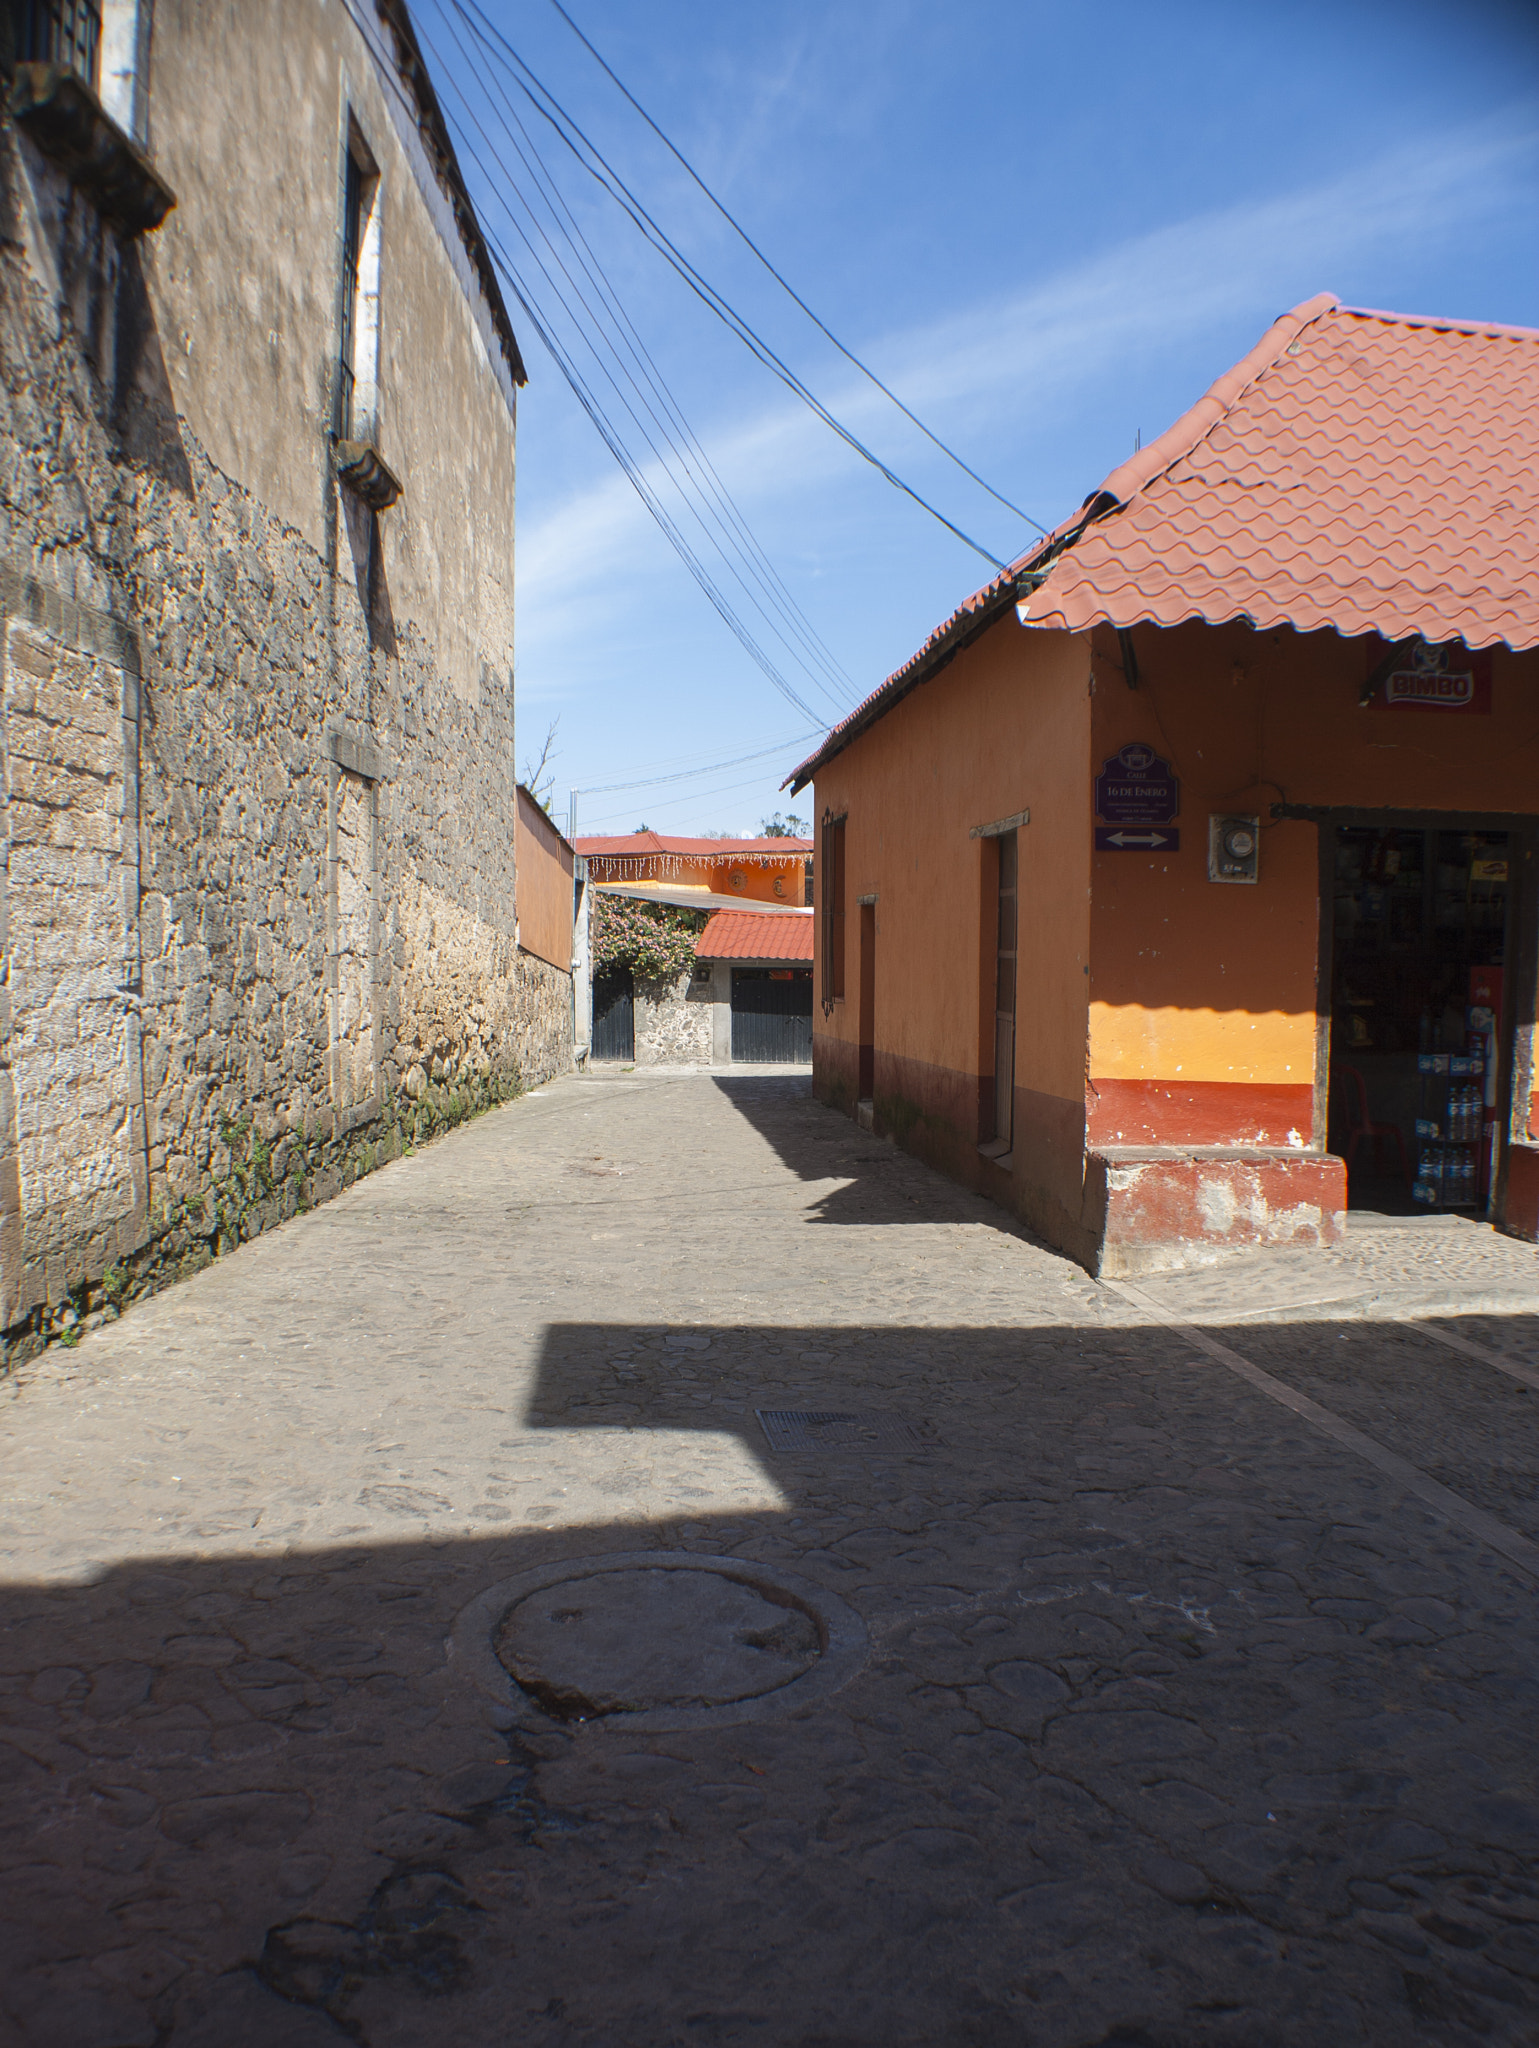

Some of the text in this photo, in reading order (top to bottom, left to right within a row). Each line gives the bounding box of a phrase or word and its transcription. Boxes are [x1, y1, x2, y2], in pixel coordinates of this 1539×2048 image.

[1392, 675, 1468, 697] BIMBO
[1108, 786, 1167, 797] 16 DE ENERO
